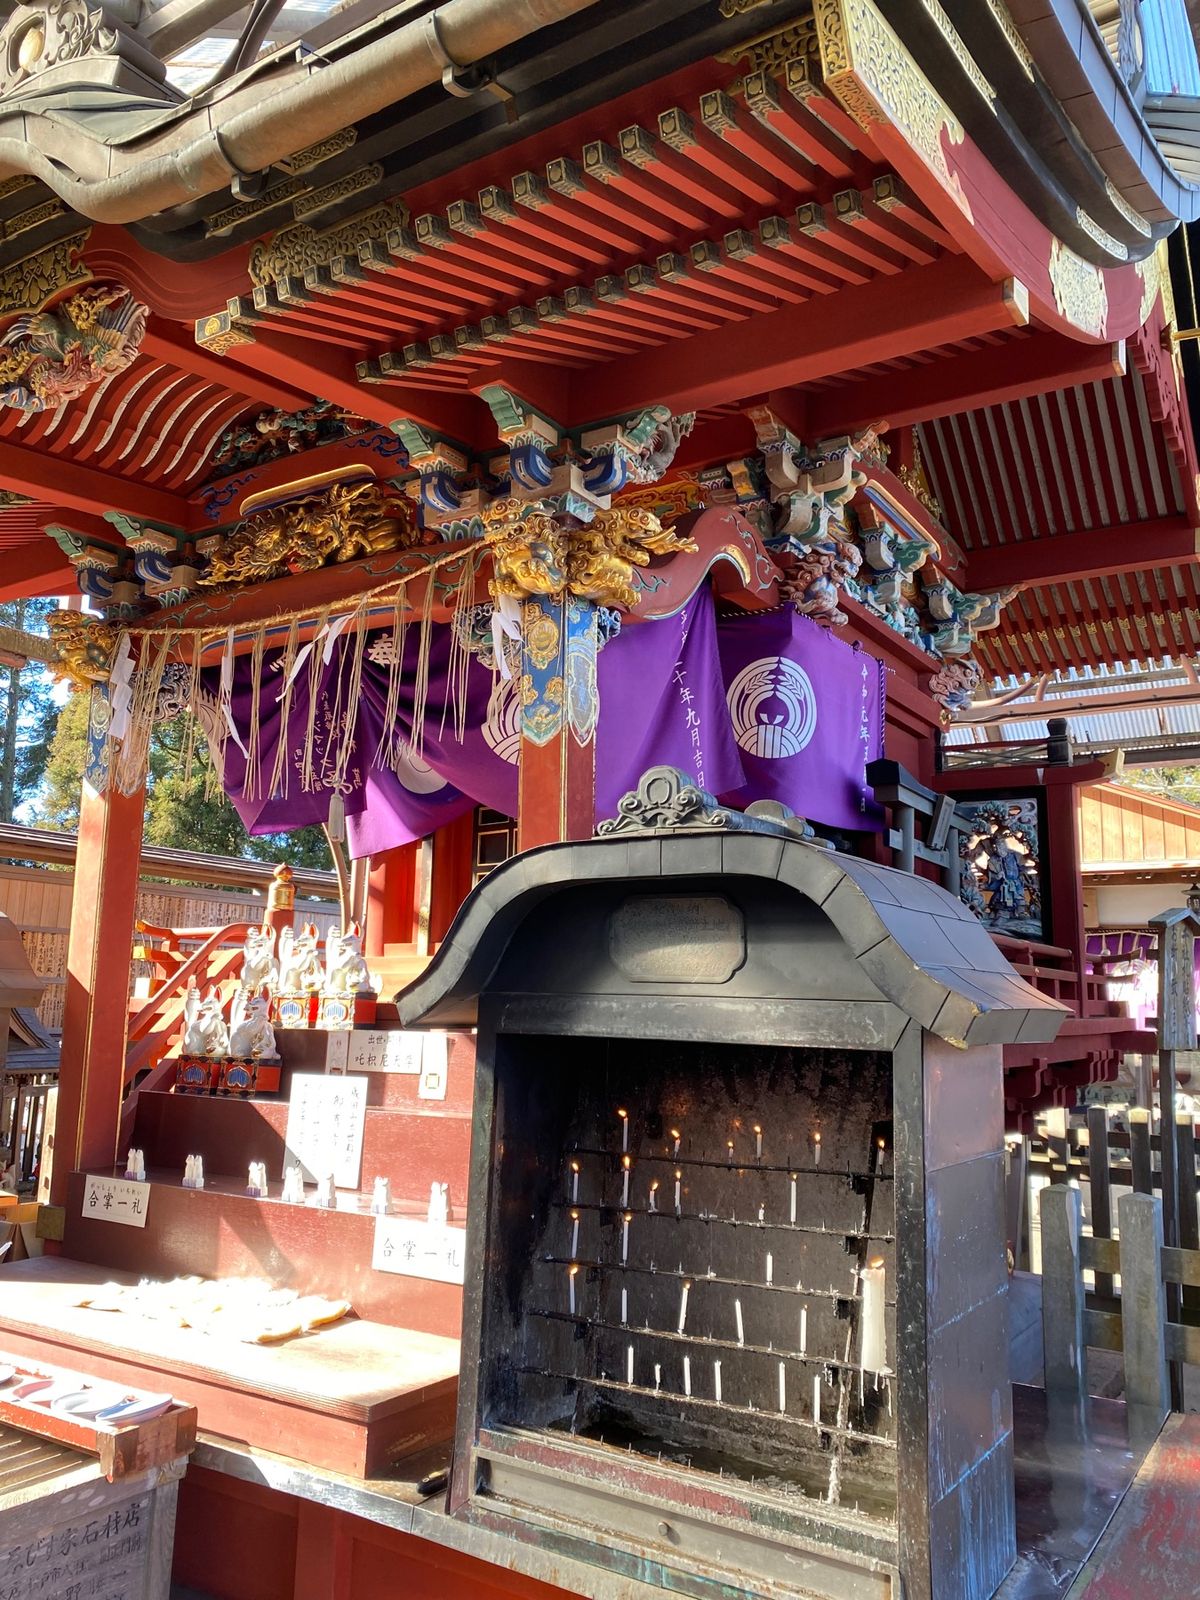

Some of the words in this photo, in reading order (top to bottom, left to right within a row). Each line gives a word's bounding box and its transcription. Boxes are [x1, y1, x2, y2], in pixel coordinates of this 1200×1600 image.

[88, 1190, 142, 1215] 合掌一礼
[383, 1237, 460, 1268] 合掌一礼
